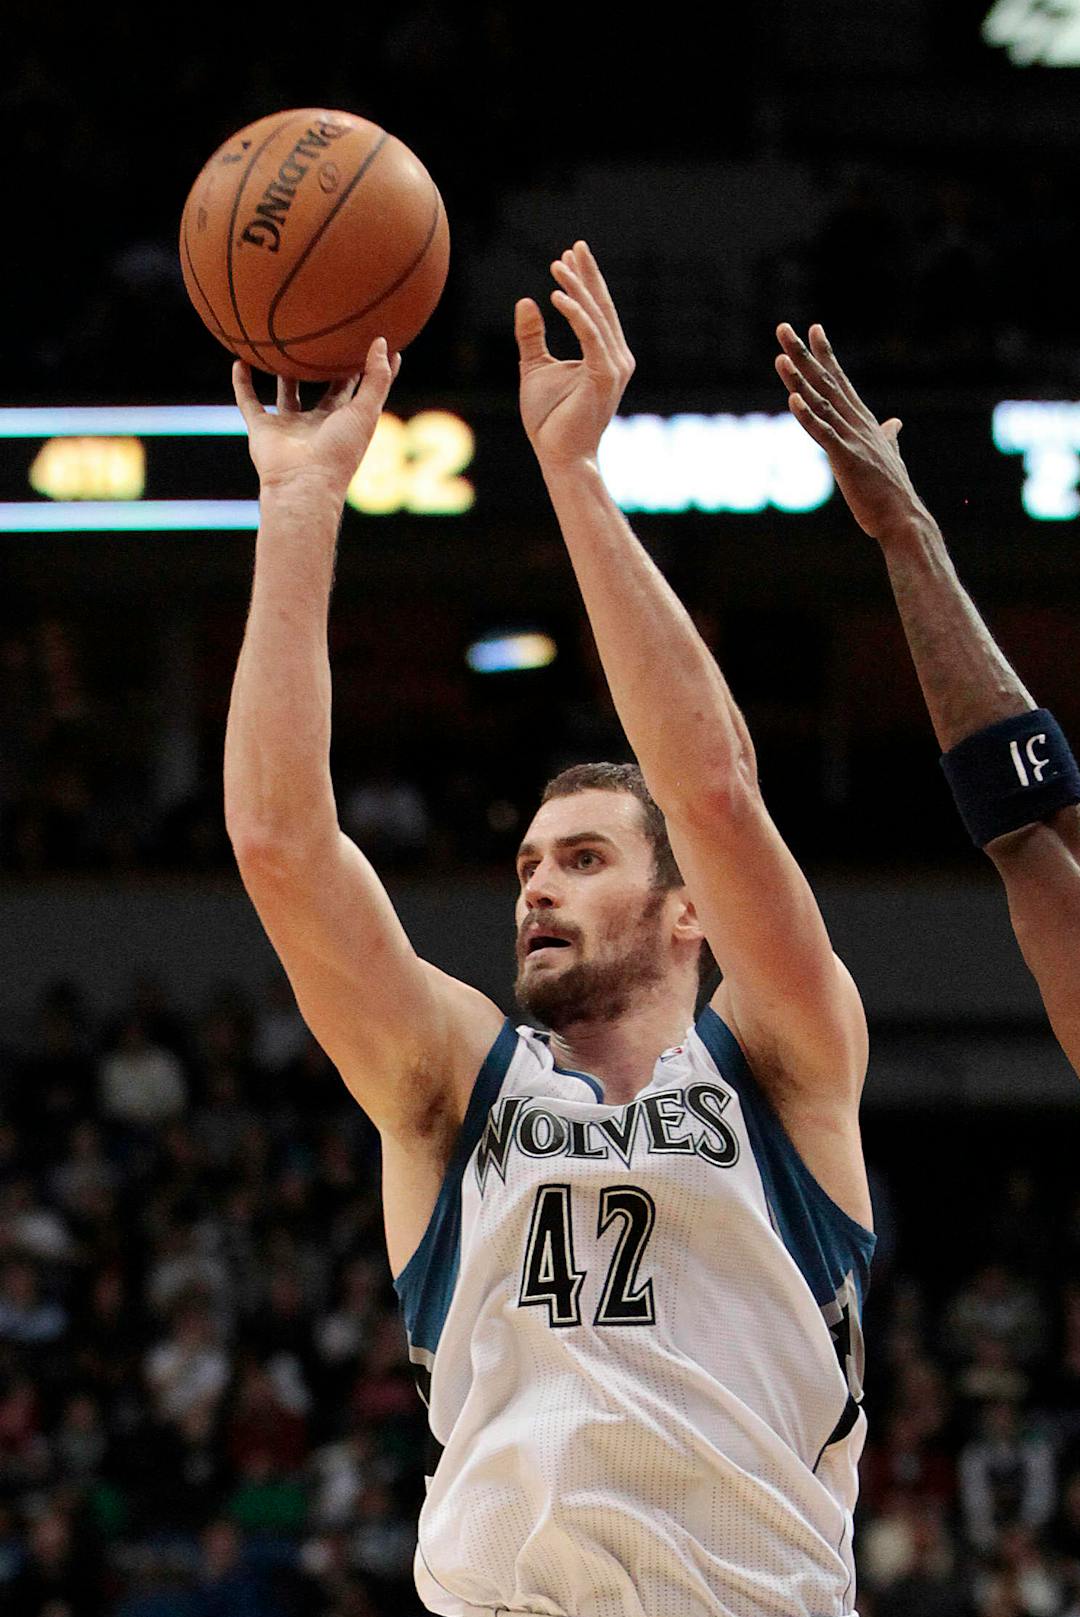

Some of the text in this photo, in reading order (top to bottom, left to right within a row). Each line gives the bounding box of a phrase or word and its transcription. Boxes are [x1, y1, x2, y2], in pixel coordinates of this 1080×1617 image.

[240, 118, 346, 253] PALDING
[474, 1081, 740, 1199] WOLVES
[518, 1183, 656, 1328] 42
